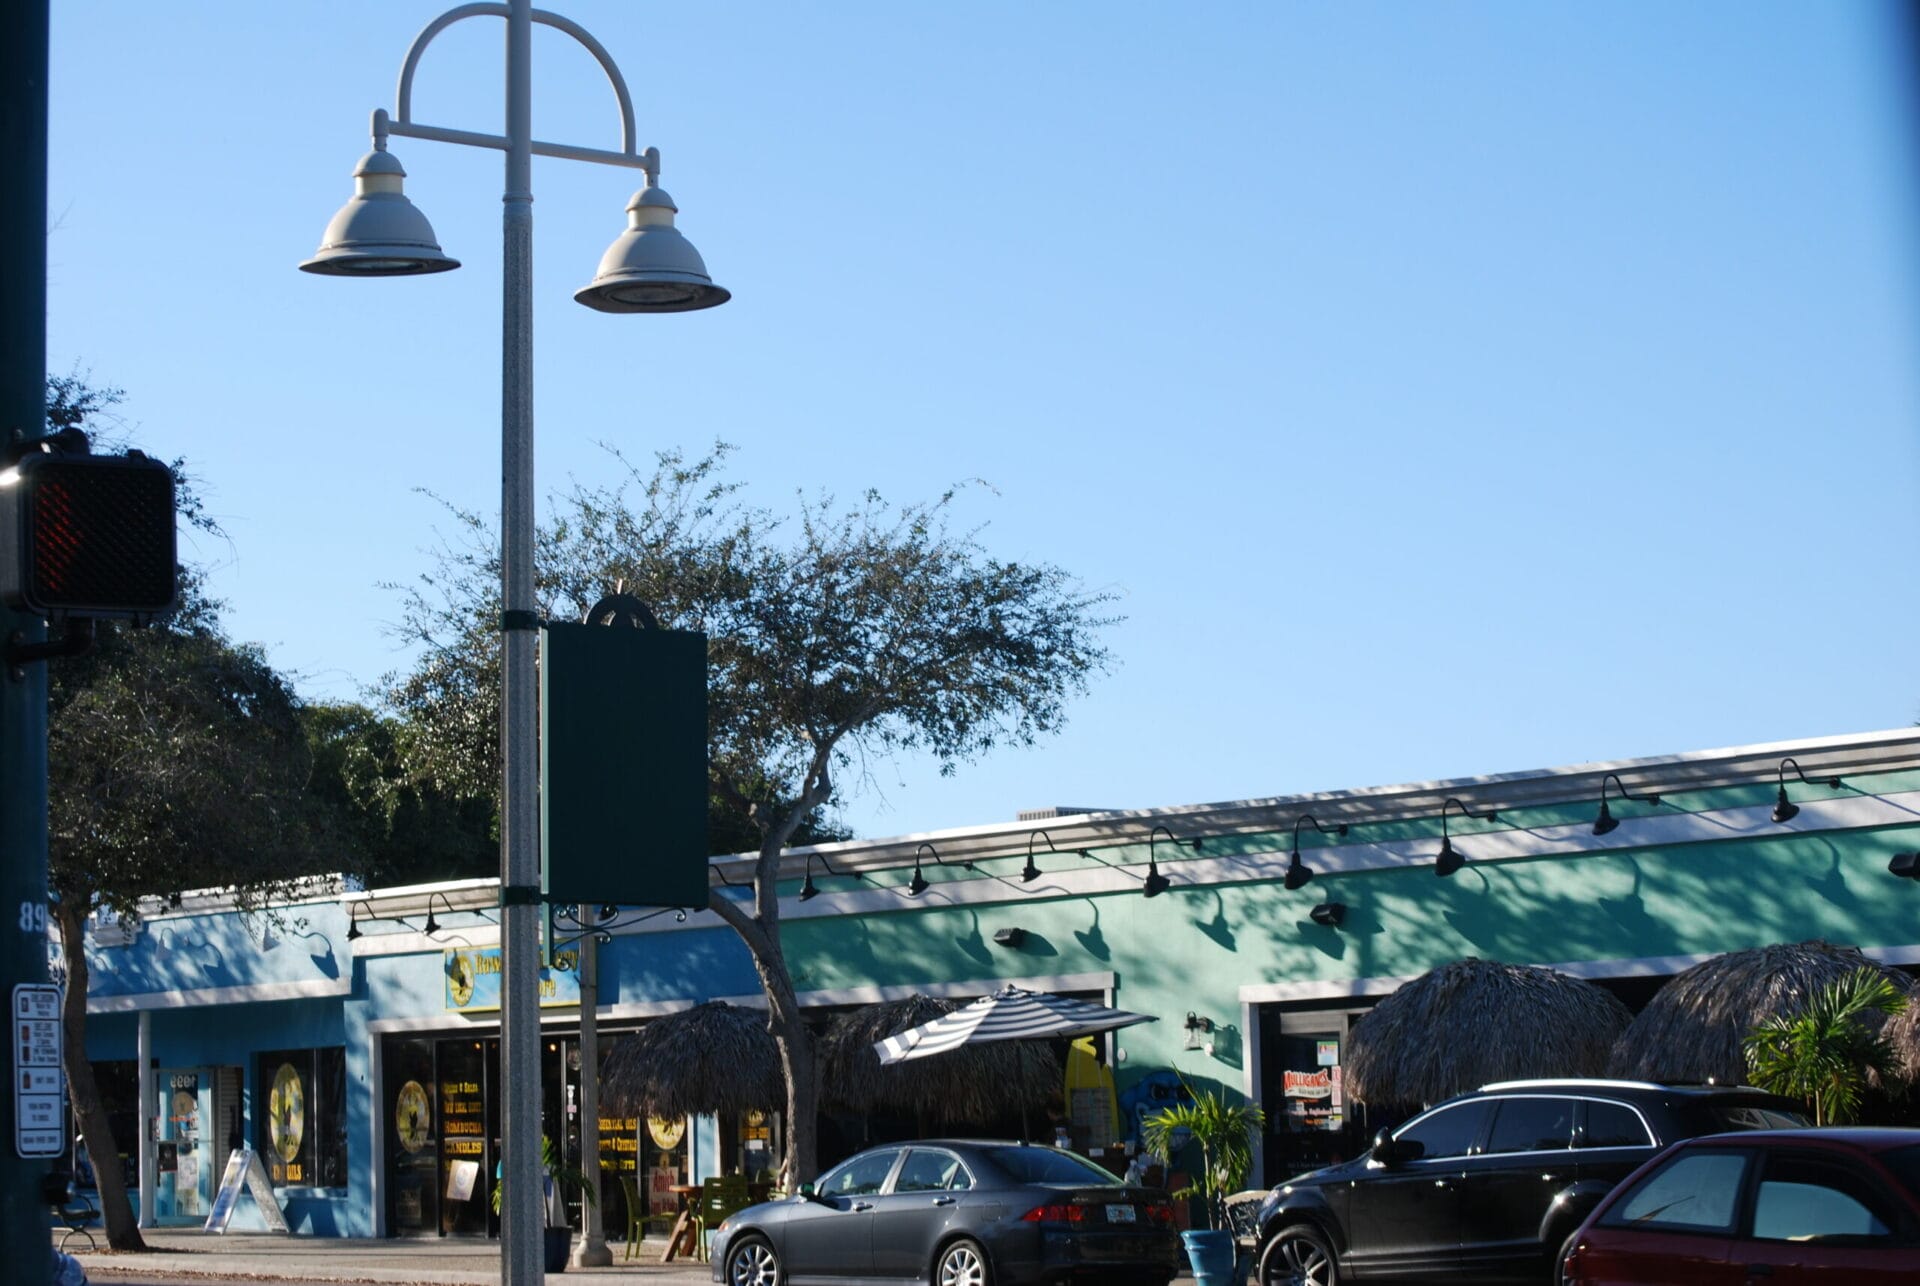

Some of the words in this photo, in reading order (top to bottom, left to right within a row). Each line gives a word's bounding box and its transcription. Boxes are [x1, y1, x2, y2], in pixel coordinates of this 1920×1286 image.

[474, 953, 501, 975] Raw
[445, 1142, 482, 1154] CANDLES
[287, 1164, 302, 1180] OILS
